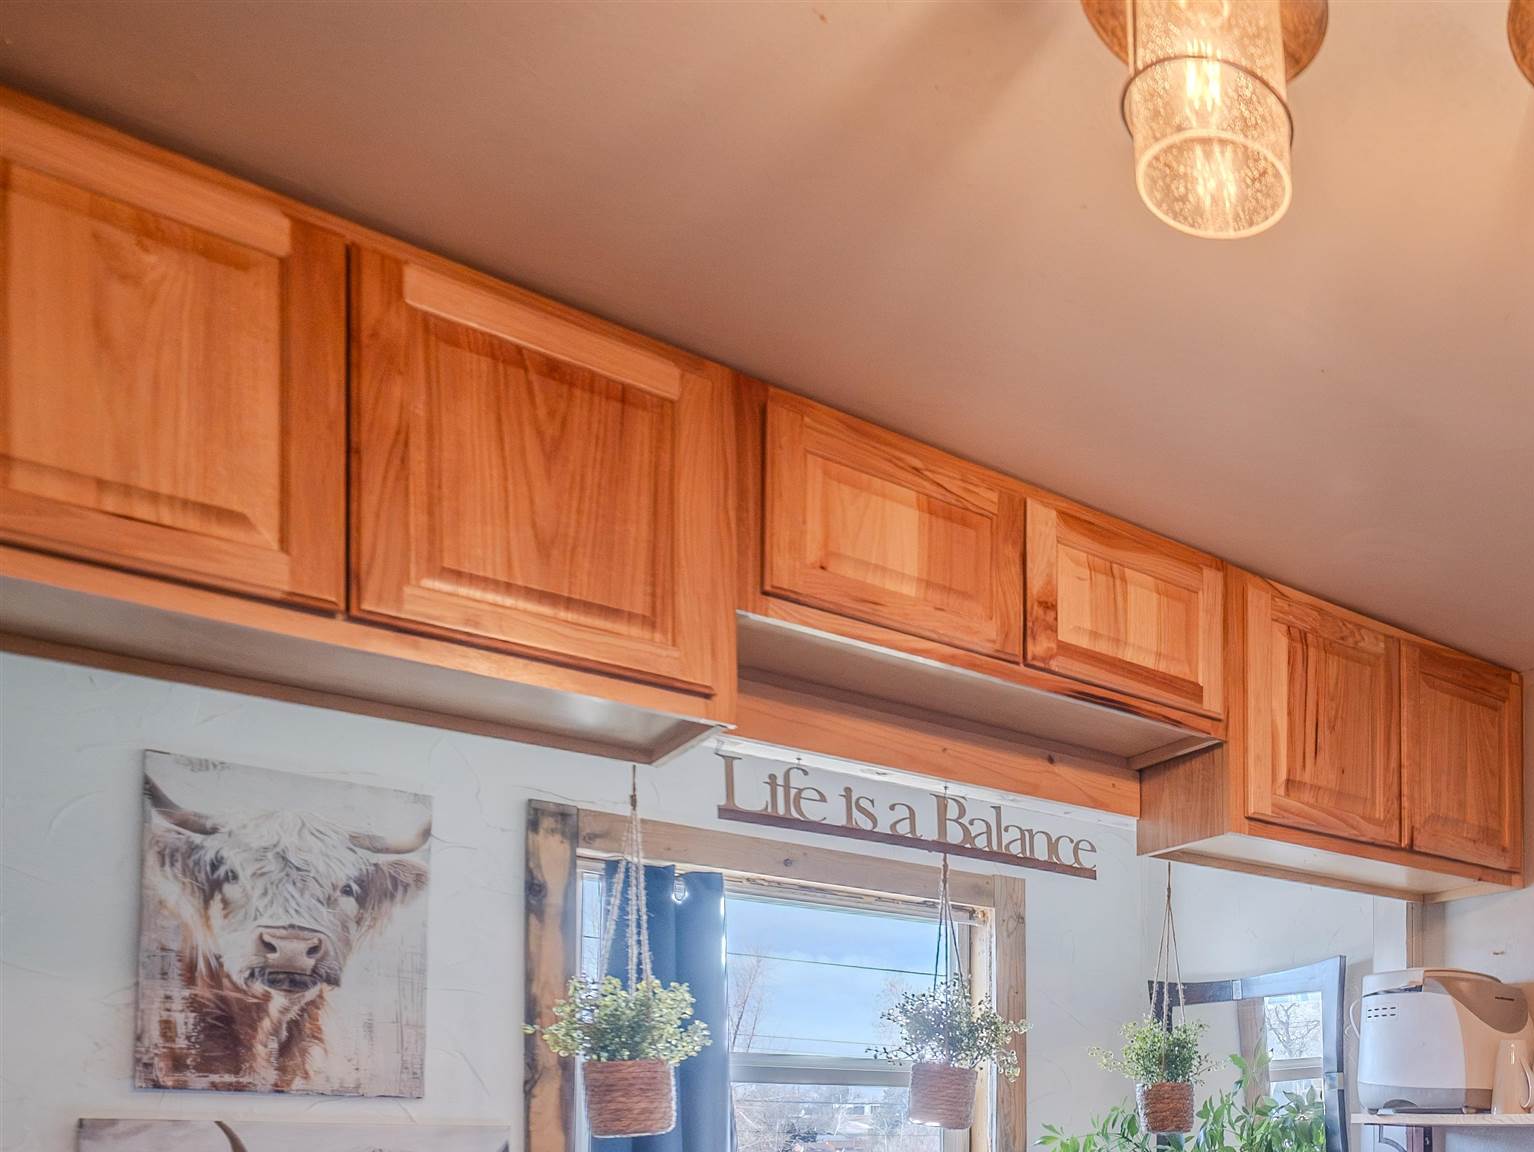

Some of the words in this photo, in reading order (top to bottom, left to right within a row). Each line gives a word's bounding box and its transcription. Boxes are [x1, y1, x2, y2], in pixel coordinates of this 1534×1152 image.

[714, 751, 828, 824] Life
[839, 785, 878, 832] is
[889, 801, 923, 840] a
[929, 793, 1098, 870] Balance
